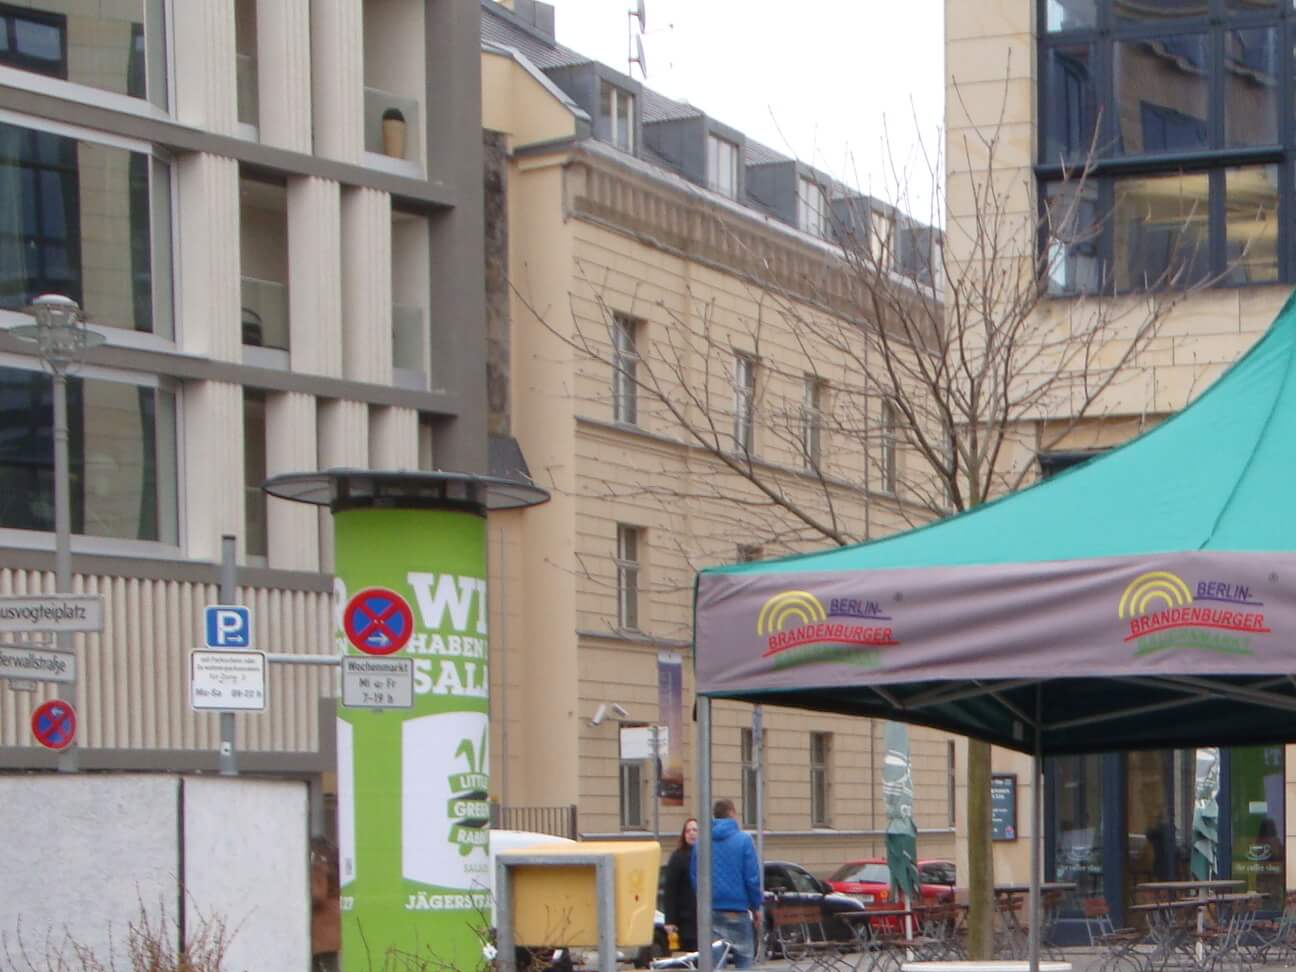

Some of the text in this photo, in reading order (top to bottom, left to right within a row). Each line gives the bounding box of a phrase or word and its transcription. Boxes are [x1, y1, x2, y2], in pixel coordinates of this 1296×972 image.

[1197, 581, 1253, 600] BERLIN-
[0, 603, 86, 624] usvogteiplatz
[830, 598, 882, 615] BERLIN-
[217, 610, 243, 644] P
[1130, 607, 1264, 635] BRANDENBURGER
[768, 624, 893, 650] BRANDENBURGER
[348, 662, 408, 672] Wochenmarkt
